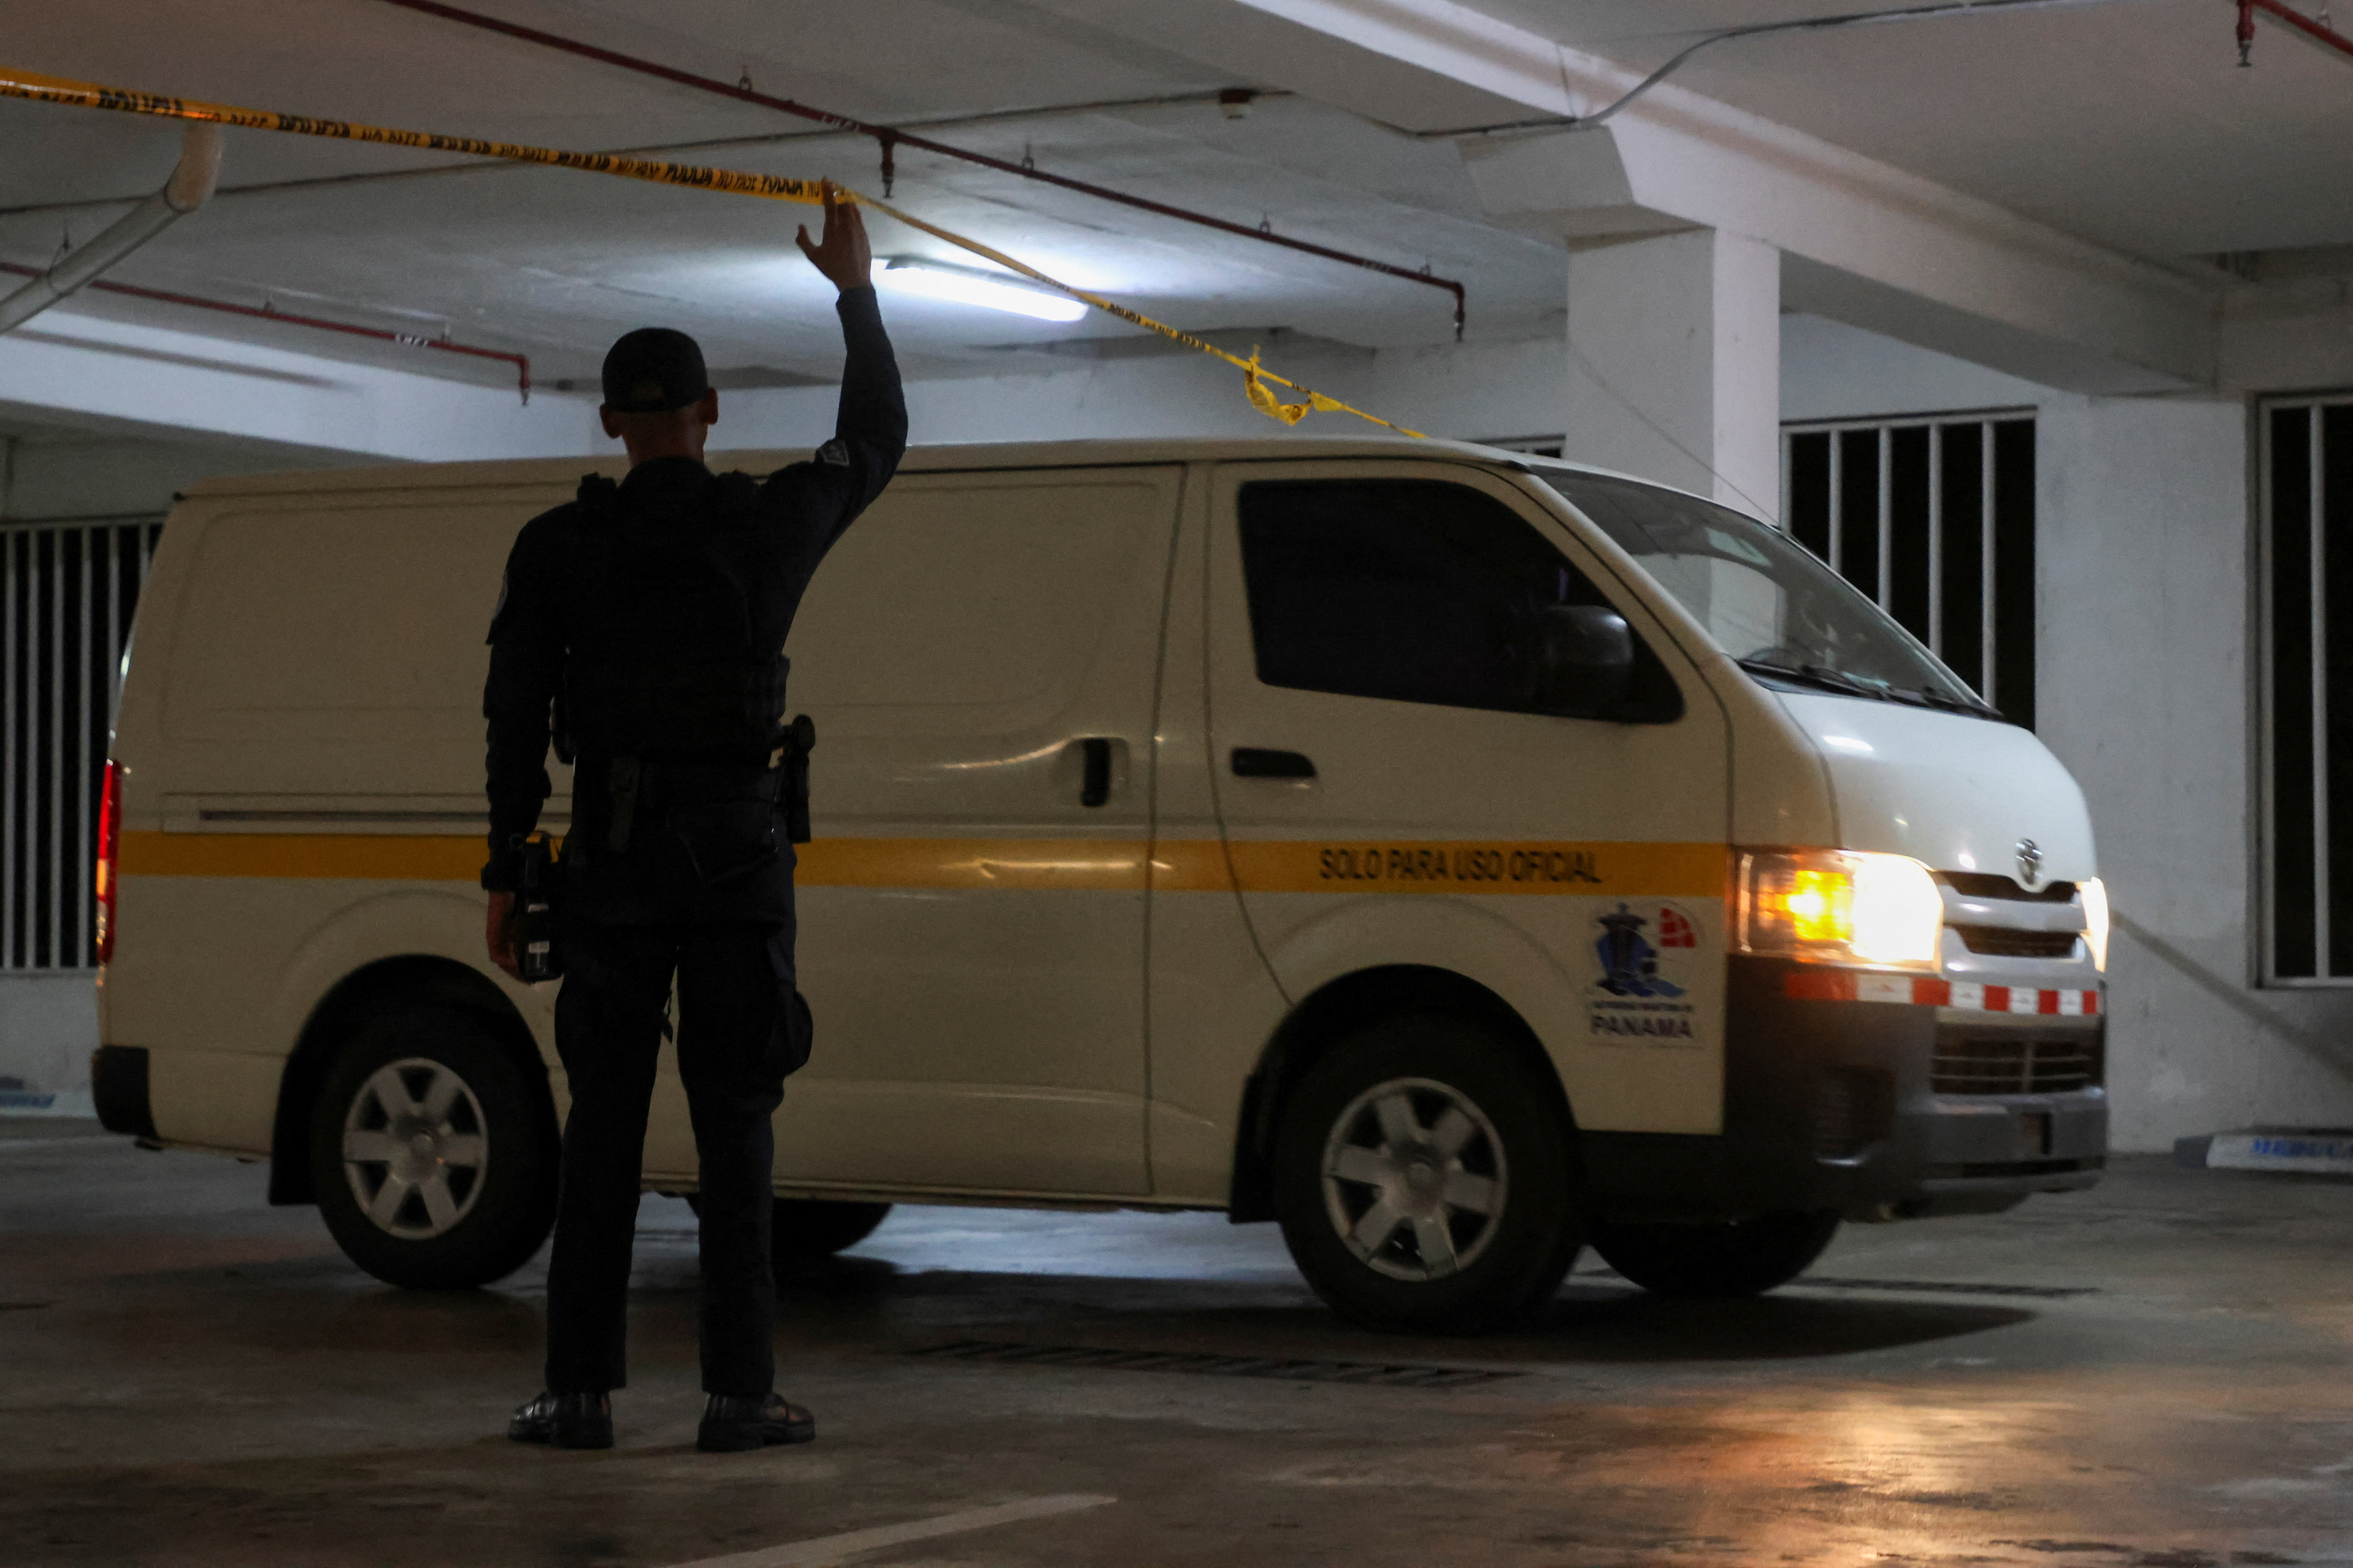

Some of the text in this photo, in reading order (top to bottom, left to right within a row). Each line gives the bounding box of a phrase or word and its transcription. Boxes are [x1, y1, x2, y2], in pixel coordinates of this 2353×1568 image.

[1319, 849, 1603, 884] SOLO PARA USO OFICIAL
